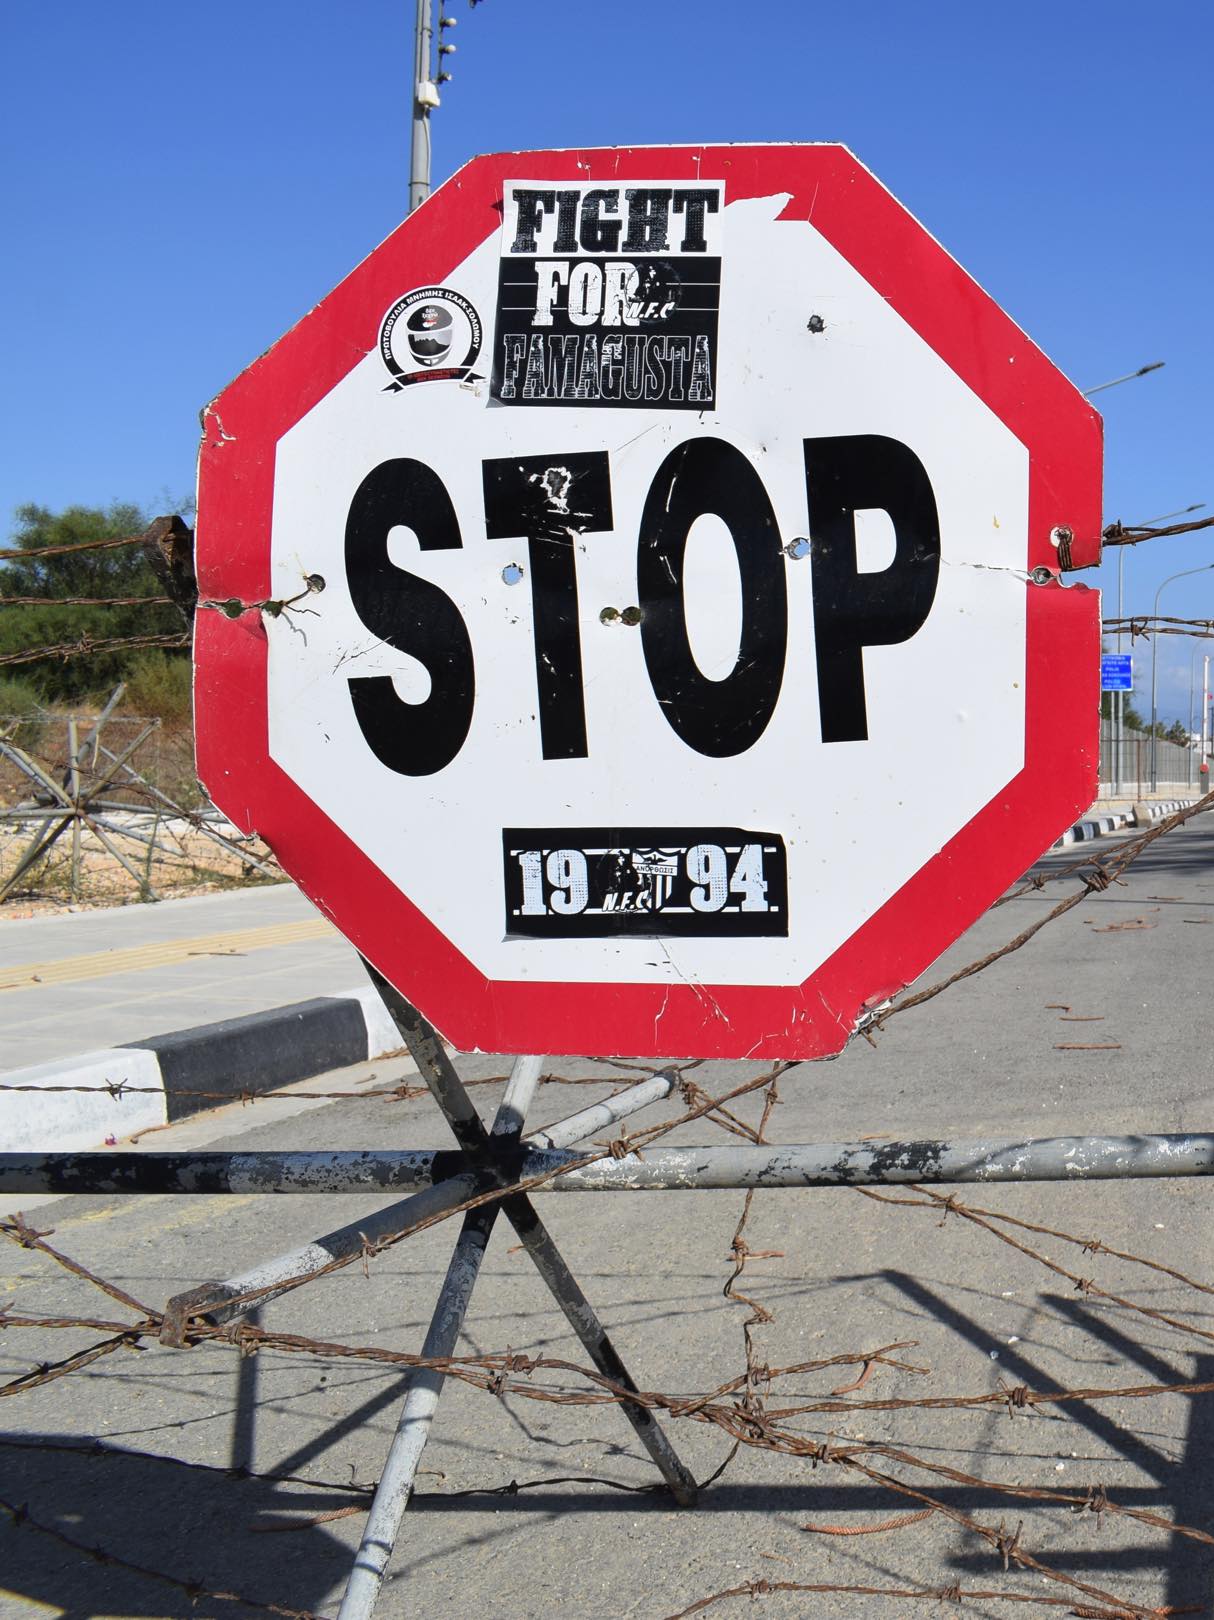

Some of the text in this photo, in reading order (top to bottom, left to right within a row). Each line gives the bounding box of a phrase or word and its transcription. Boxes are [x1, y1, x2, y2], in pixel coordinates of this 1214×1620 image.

[510, 188, 720, 253] FIGHT
[383, 303, 407, 360] ΠΡΩΤΟΒΟΥΛΙΑ
[406, 290, 444, 305] ΜΝΗΜΗΣ
[531, 261, 641, 327] FOR
[501, 334, 713, 402] FAMAGUSTA
[344, 434, 941, 776] STOP
